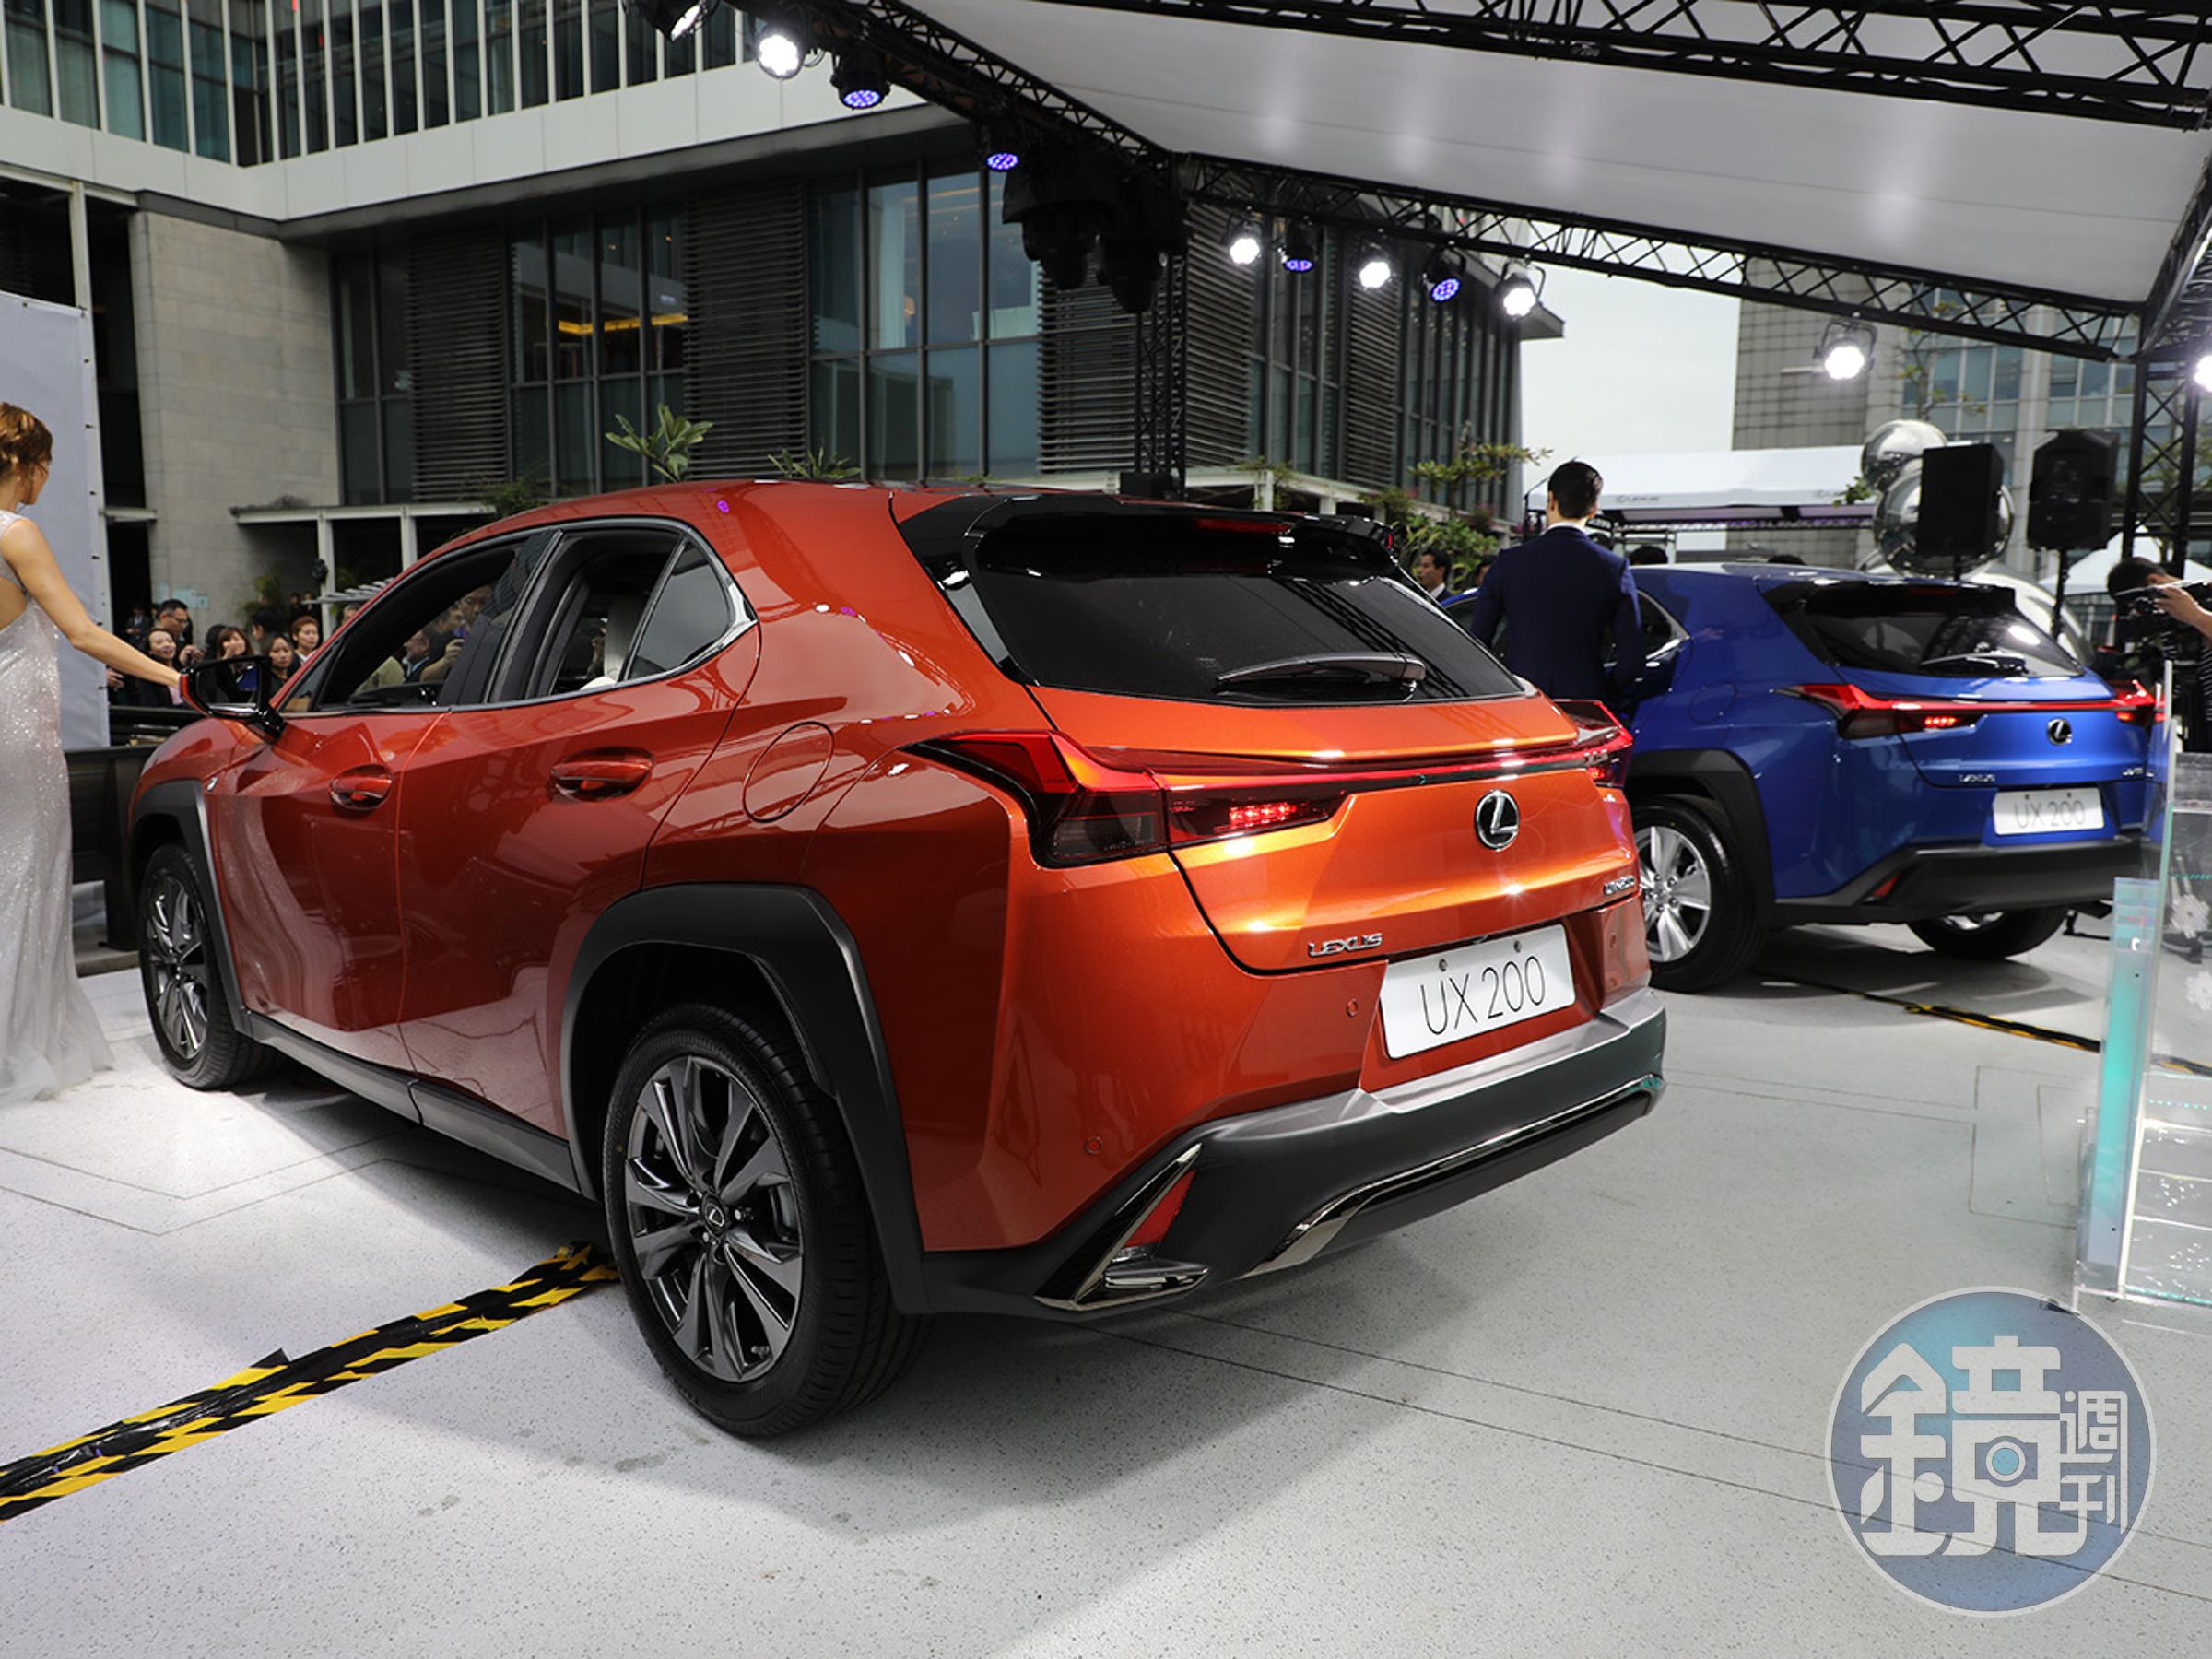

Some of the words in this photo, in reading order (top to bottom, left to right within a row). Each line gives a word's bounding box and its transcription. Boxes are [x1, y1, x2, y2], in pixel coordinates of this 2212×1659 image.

[2014, 802, 2044, 829] UX
[2049, 799, 2086, 828] 200
[1308, 933, 1382, 957] LEXUS
[1419, 972, 1478, 1035] UX
[1481, 955, 1546, 1020] 200
